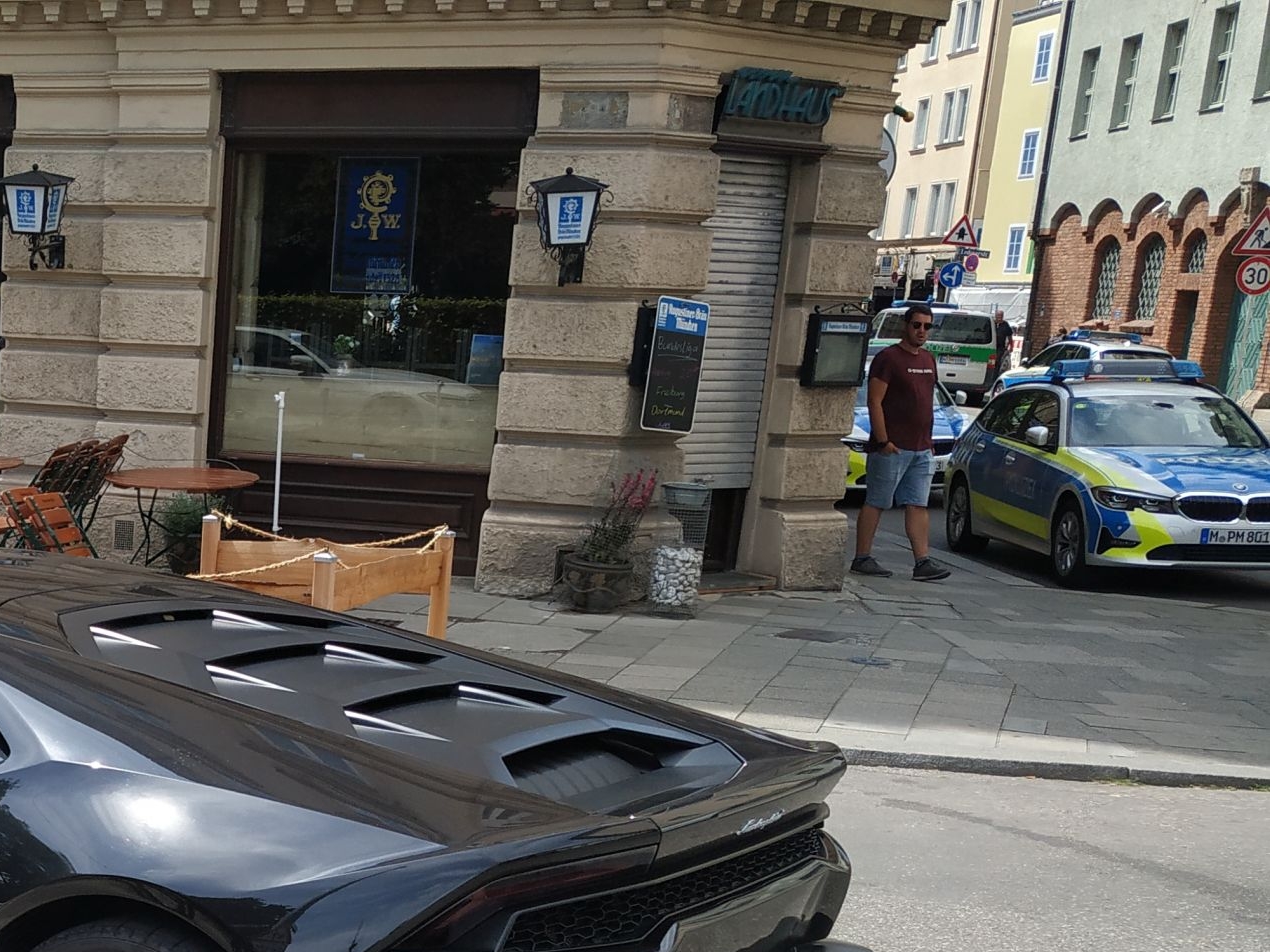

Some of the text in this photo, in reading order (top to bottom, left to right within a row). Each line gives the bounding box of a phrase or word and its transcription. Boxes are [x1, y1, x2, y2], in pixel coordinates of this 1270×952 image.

[1245, 267, 1268, 285] 30
[651, 404, 686, 417] Dortmund
[1209, 531, 1219, 542] M
[1227, 531, 1245, 543] PM
